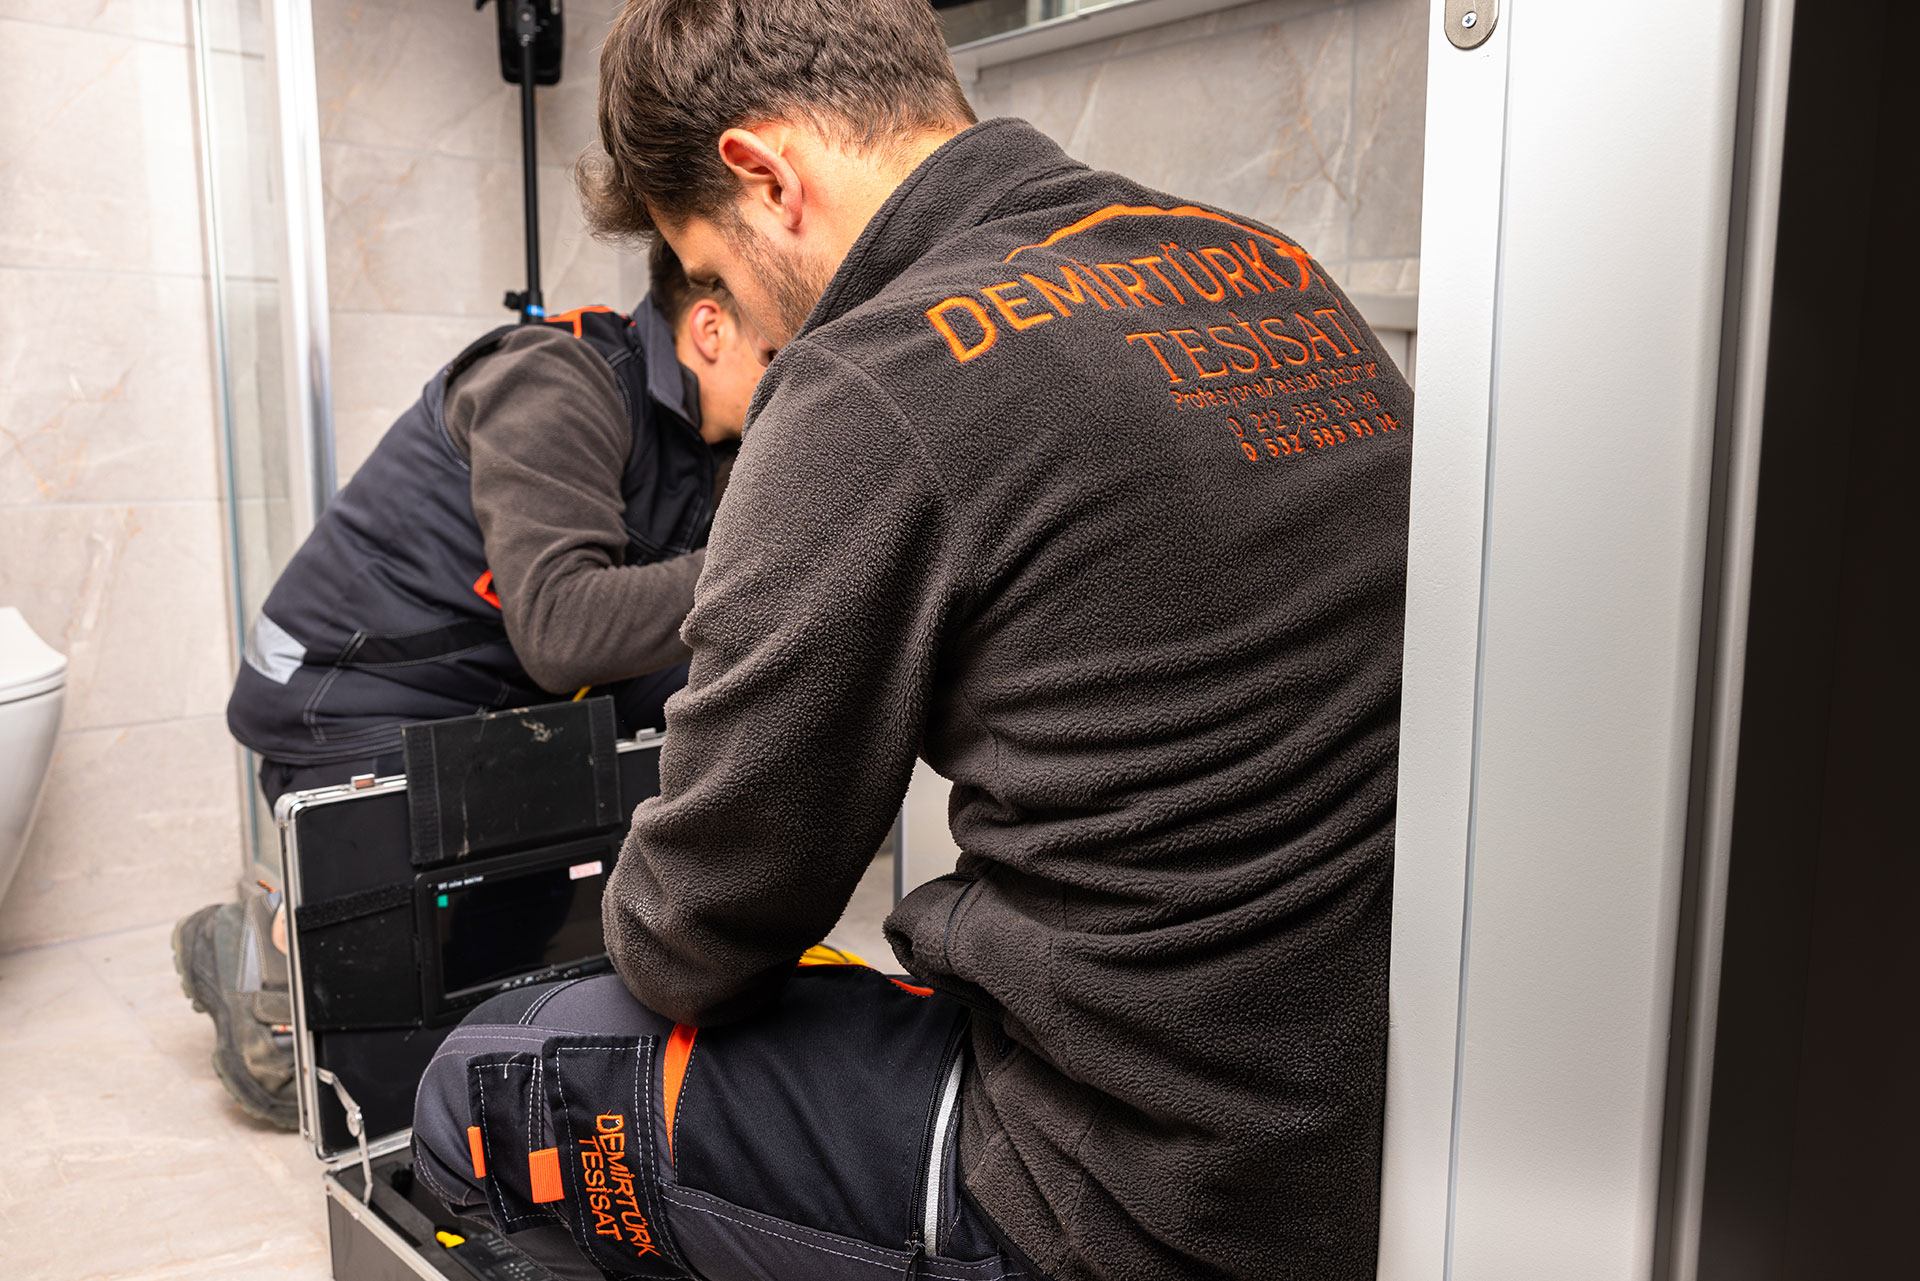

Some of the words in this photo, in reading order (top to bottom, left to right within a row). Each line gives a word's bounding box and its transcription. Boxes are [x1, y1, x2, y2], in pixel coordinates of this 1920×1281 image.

[925, 240, 1291, 364] DEMİRTÜRK
[1126, 309, 1360, 384] TESİSAT
[1227, 417, 1244, 437] 0
[1249, 410, 1287, 433] 212
[1291, 402, 1328, 425] 555
[1241, 441, 1257, 462] 0
[1264, 434, 1306, 457] 532
[578, 1136, 623, 1241] TESİSAT
[595, 1111, 662, 1257] DEMİRTÜRK
